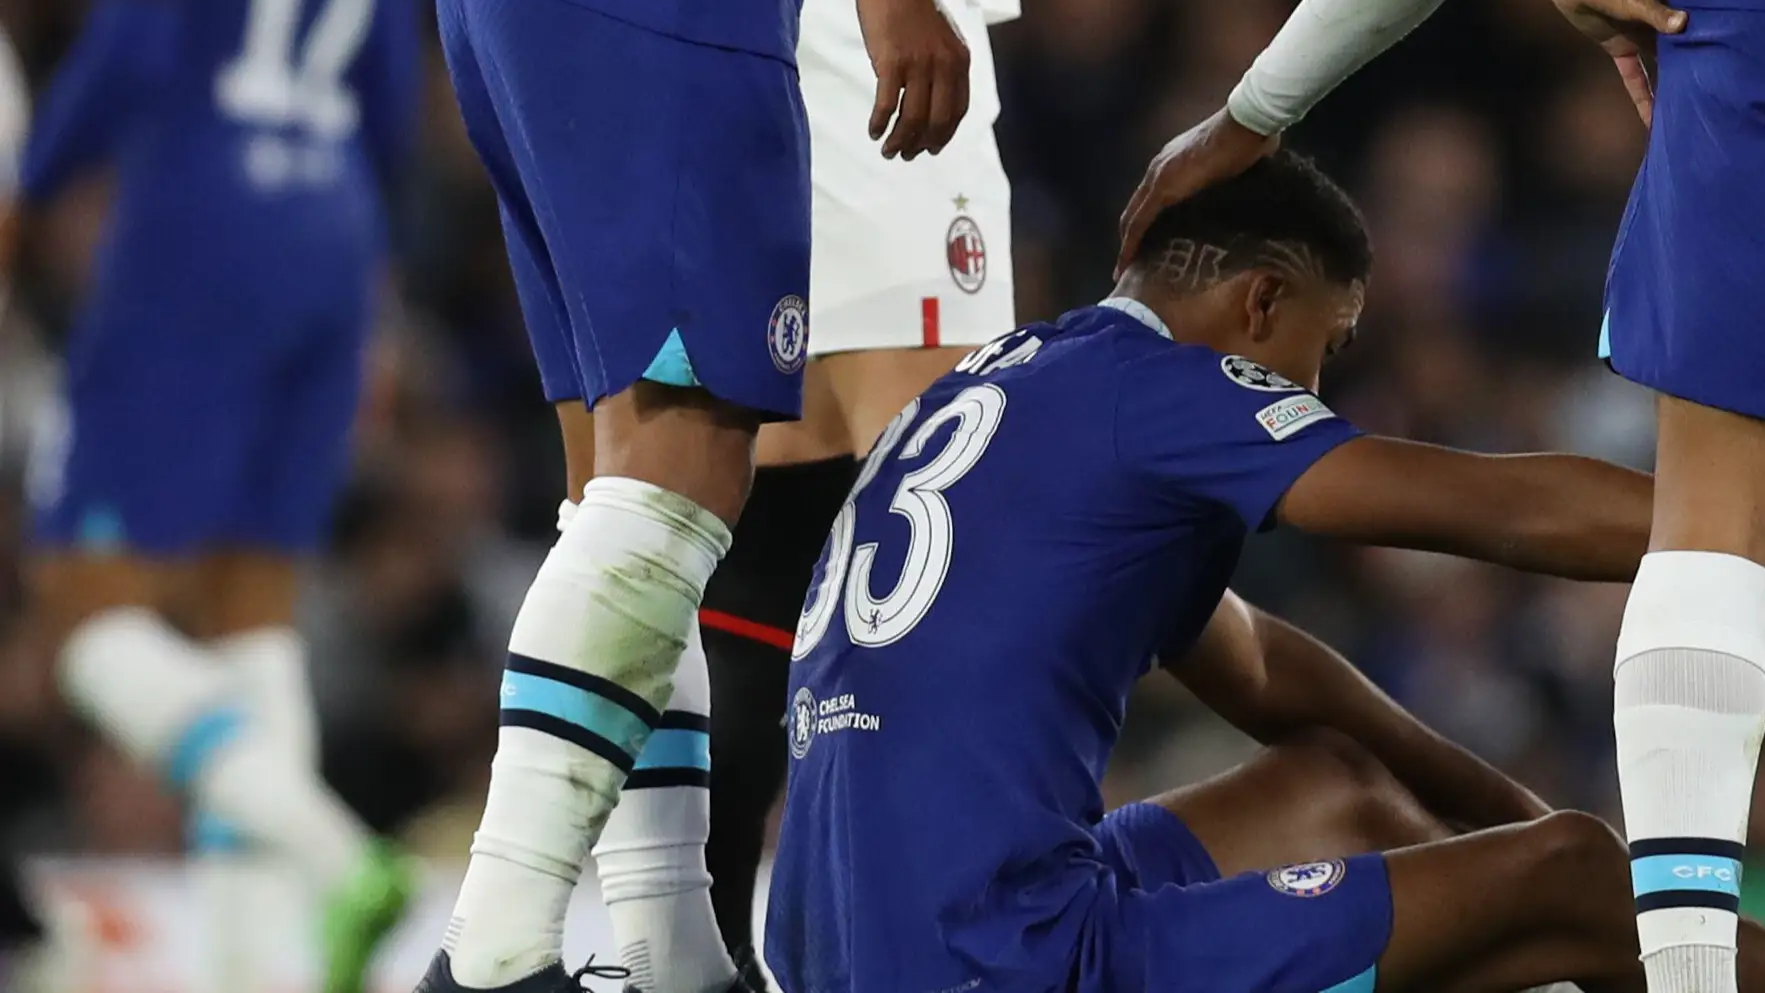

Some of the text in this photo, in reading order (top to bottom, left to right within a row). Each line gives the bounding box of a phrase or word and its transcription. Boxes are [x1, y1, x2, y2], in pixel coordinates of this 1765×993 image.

[791, 383, 1007, 661] 33
[819, 693, 855, 716] CHELSEA
[817, 712, 881, 734] FOUNDATION
[1672, 864, 1732, 882] CFC
